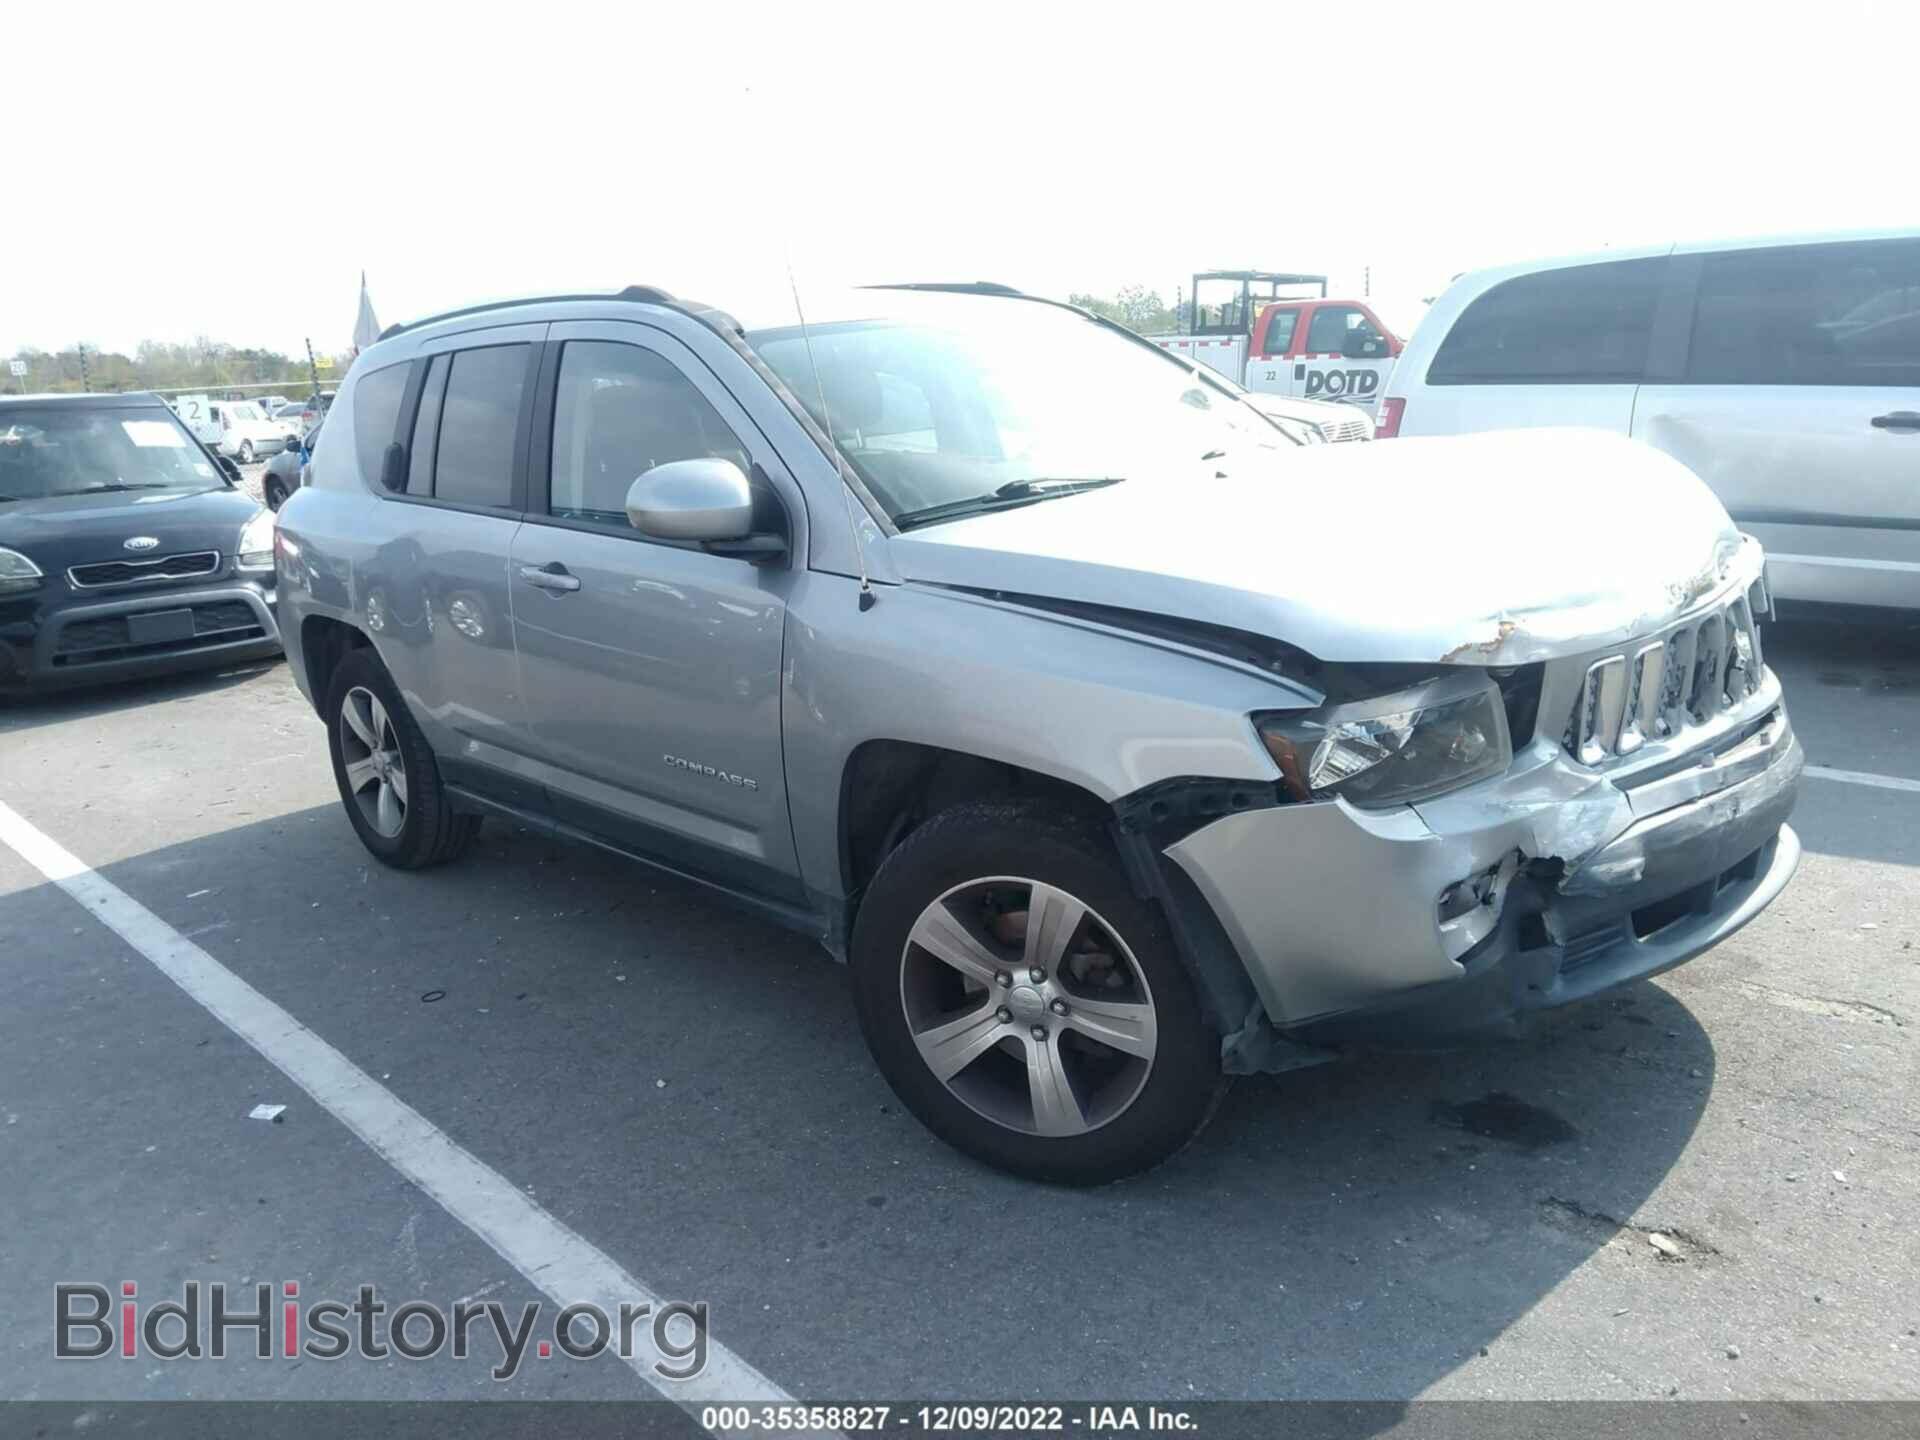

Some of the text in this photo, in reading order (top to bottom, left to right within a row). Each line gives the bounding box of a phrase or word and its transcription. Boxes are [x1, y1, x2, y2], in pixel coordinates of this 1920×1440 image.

[1265, 371, 1276, 381] 22
[1305, 369, 1379, 394] DOTD
[187, 401, 201, 419] 2
[663, 754, 759, 790] COMPASS
